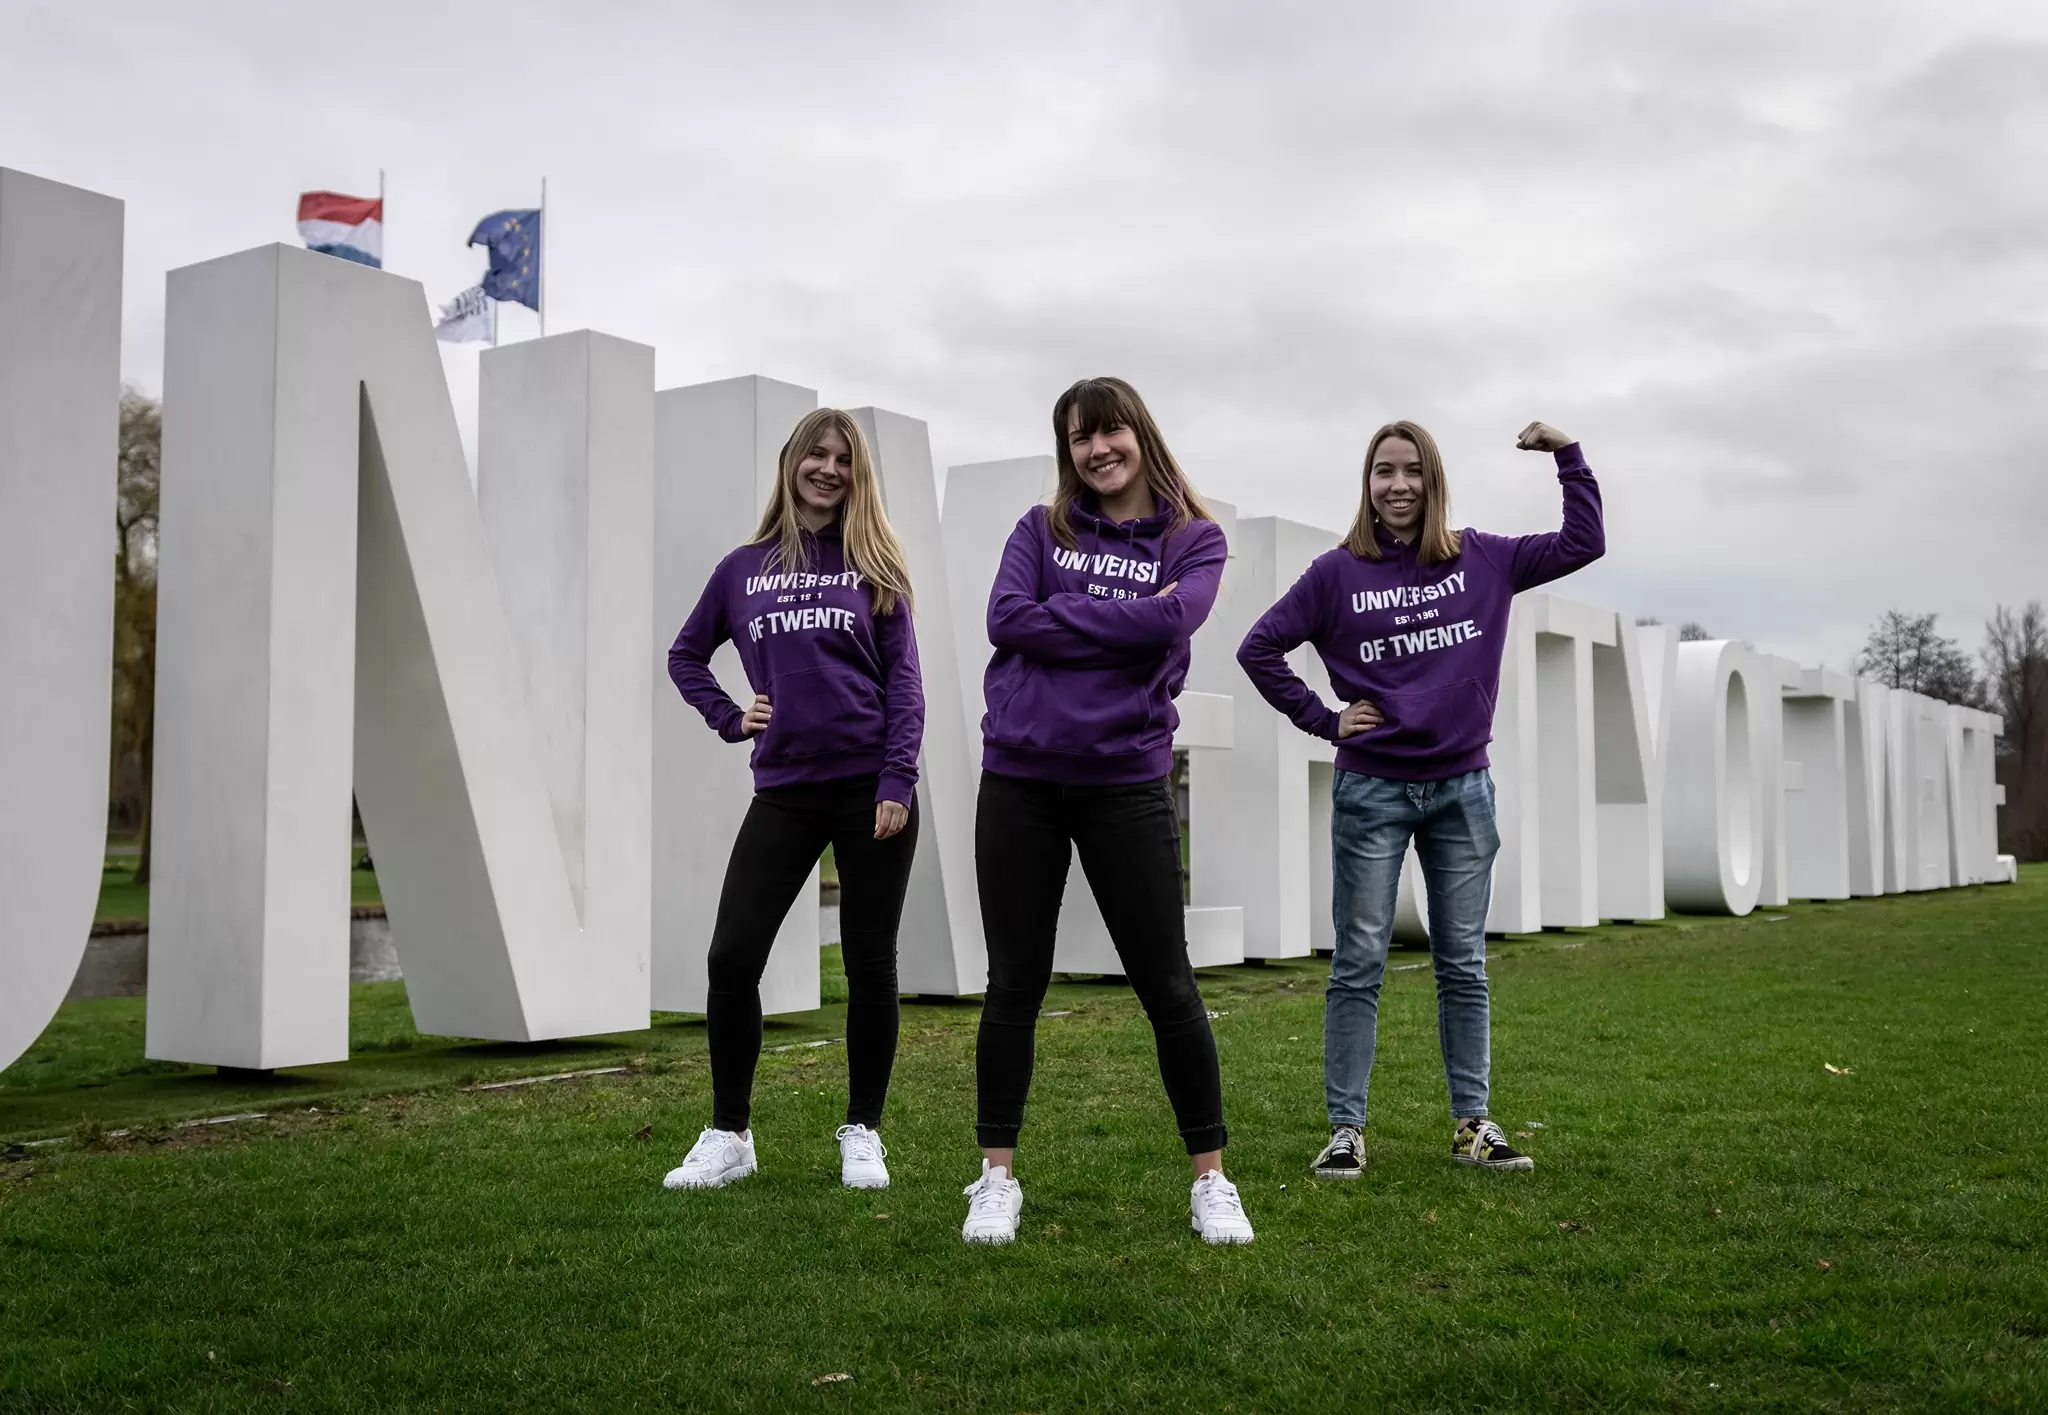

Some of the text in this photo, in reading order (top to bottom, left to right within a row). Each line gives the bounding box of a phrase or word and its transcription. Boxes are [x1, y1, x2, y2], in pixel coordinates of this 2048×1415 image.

[746, 571, 865, 597] UNIVERSITY
[1088, 583, 1108, 597] EST.
[1352, 571, 1465, 614] UNIVERSITY
[777, 595, 796, 603] EST.
[748, 615, 764, 643] OF
[1394, 608, 1440, 626] EST. 1961
[1360, 619, 1483, 663] OF TWENTE.
